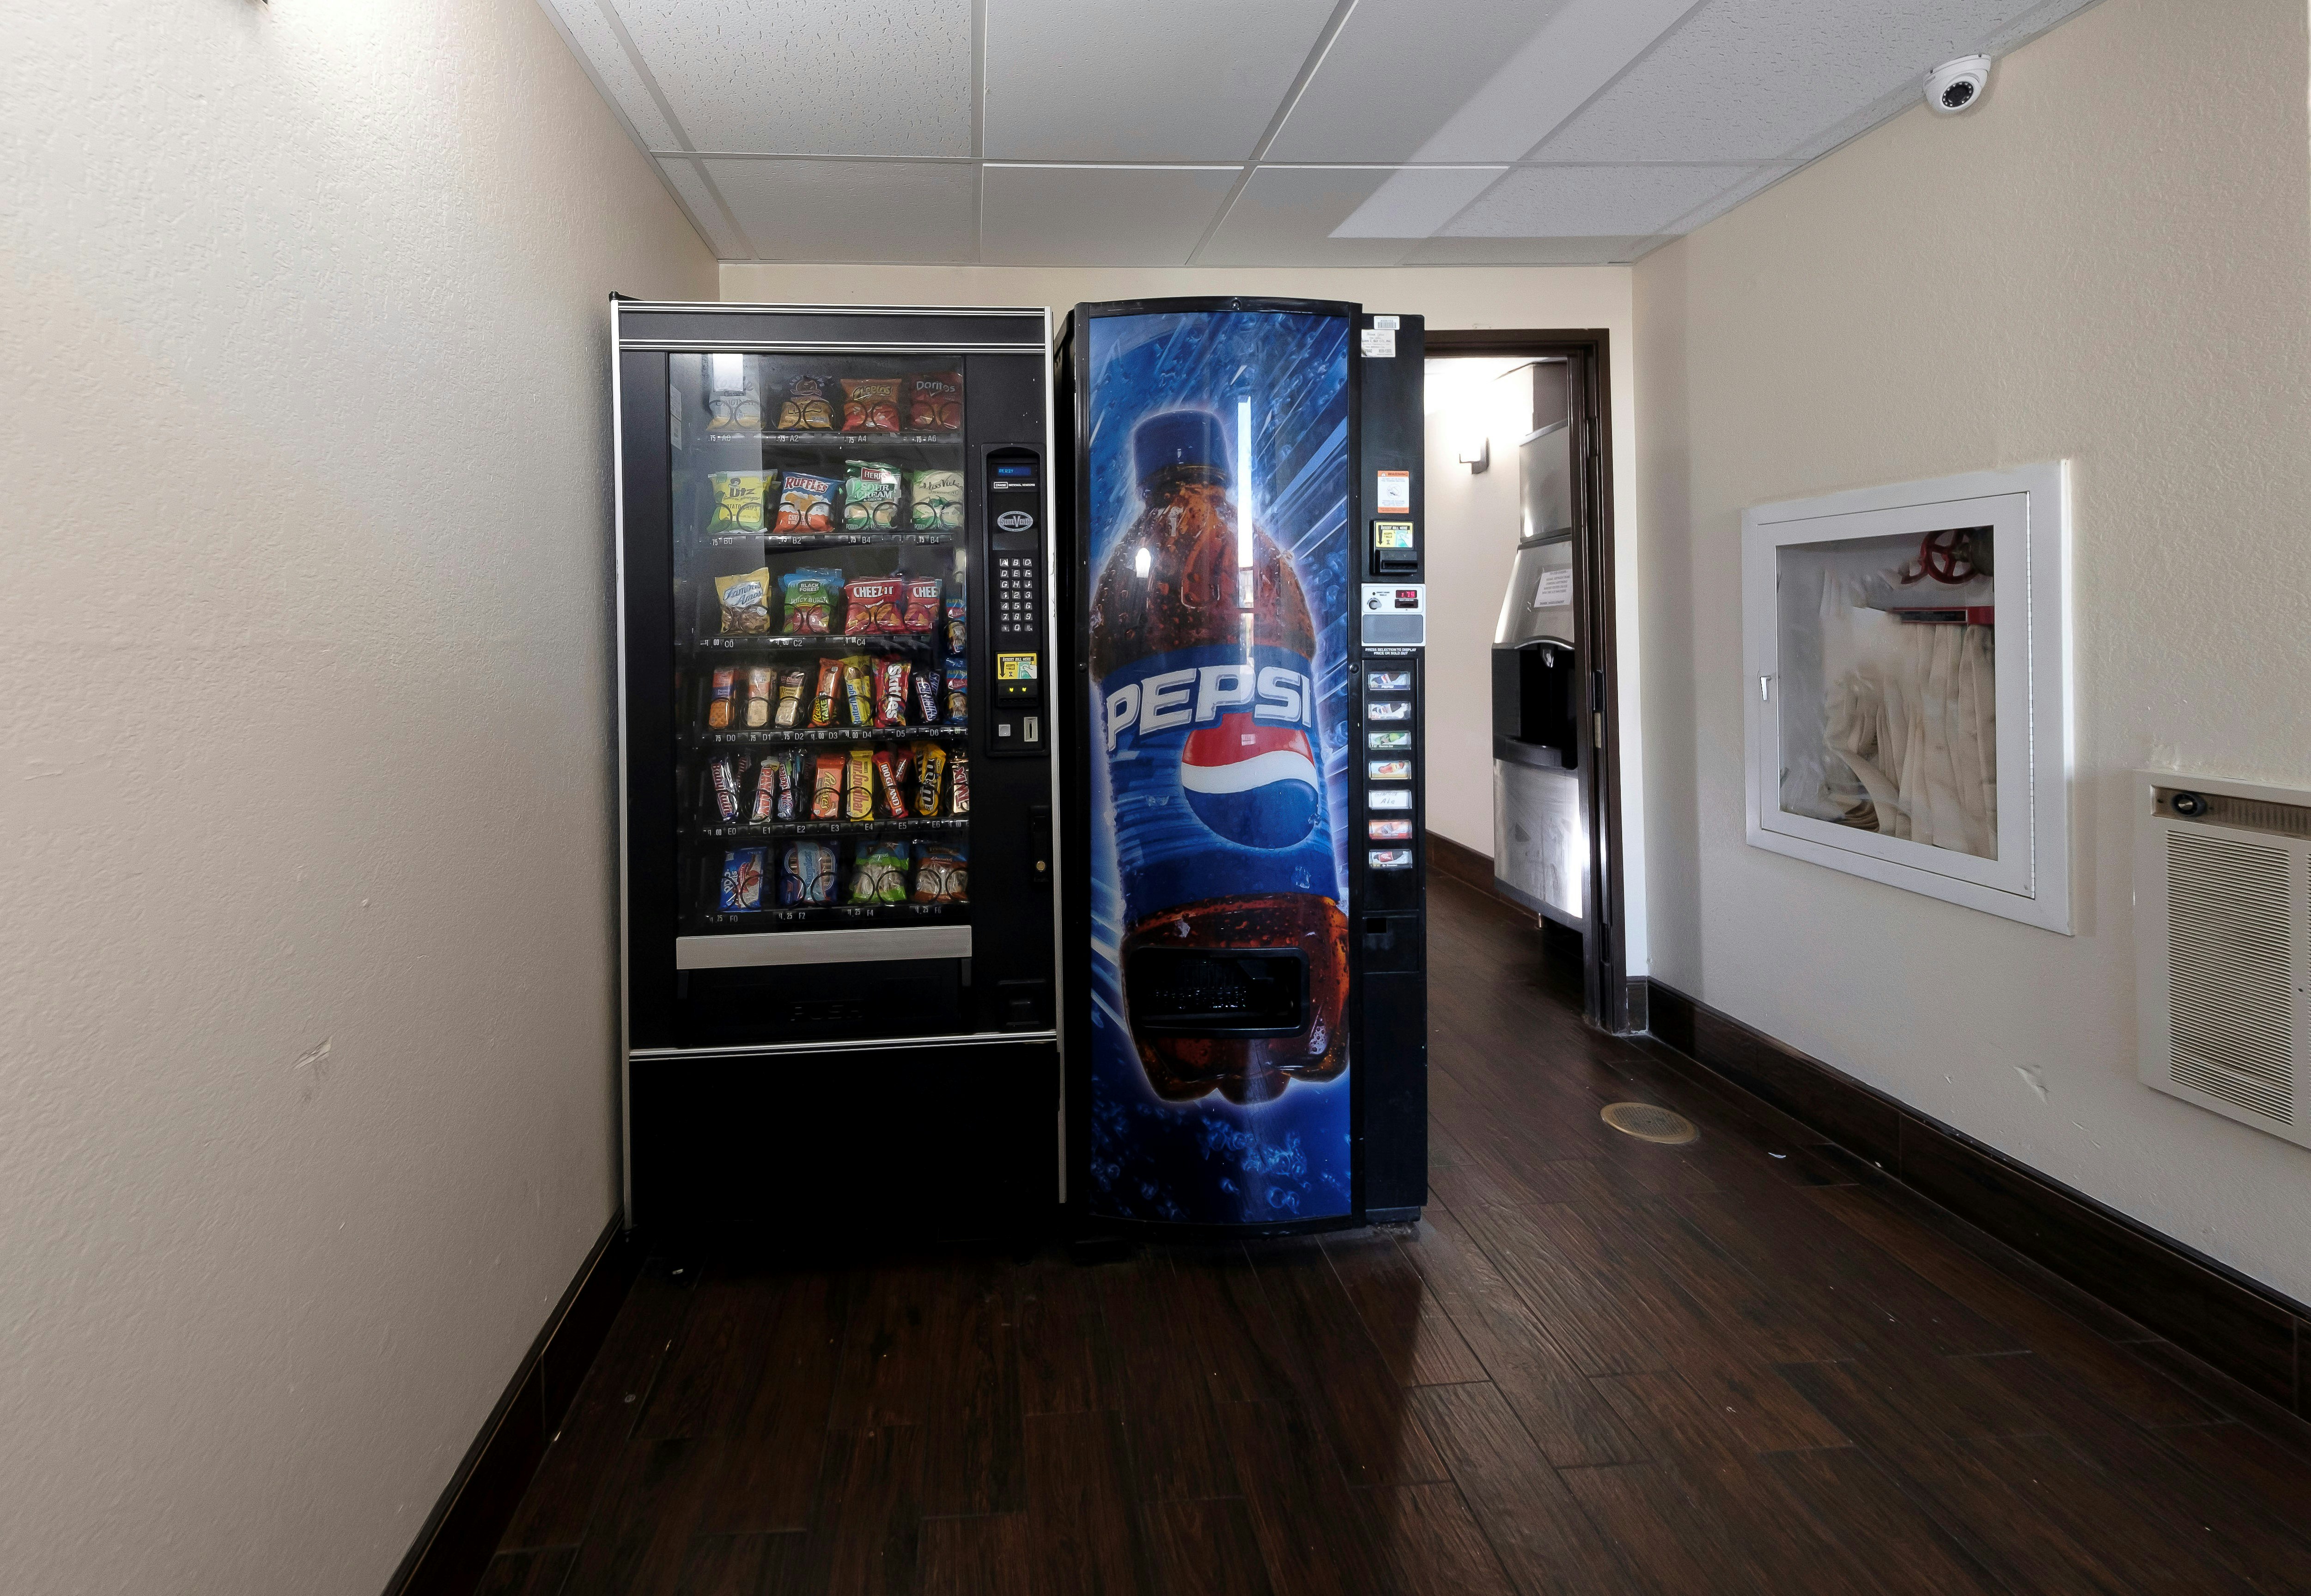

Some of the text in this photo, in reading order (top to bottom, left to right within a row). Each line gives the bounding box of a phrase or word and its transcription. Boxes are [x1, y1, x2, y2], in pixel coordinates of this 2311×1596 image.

[917, 381, 955, 392] Doritos
[785, 477, 827, 492] RUFFLES
[857, 491, 892, 499] CREAM
[886, 665, 901, 719] Skittles
[1107, 664, 1311, 751] PEPSI
